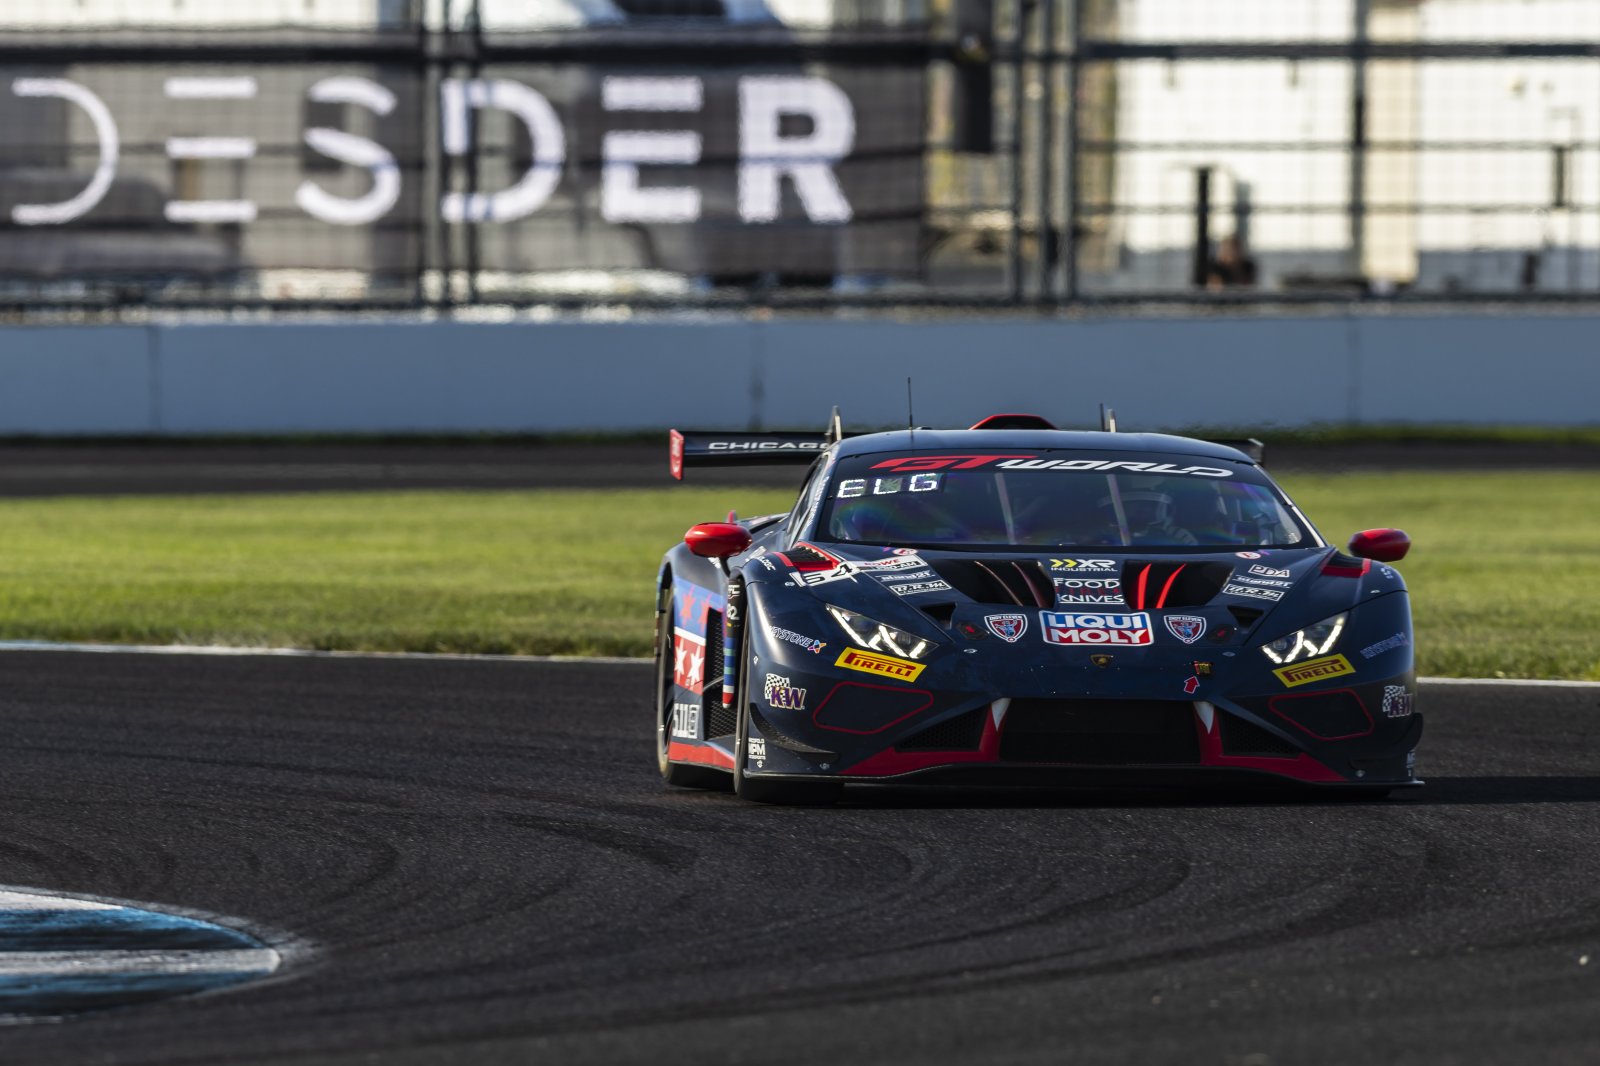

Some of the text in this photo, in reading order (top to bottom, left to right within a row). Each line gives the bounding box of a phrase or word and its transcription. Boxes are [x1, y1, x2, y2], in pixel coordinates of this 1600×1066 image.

[996, 459, 1234, 478] WORLD
[1076, 558, 1117, 568] XR
[1053, 578, 1120, 589] FOOD
[1056, 594, 1124, 603] KNIVES
[1048, 614, 1143, 629] LIQUI
[768, 626, 814, 648] EYSTONE
[1050, 629, 1147, 643] MOLY
[843, 653, 916, 677] PIRELLI
[1281, 659, 1346, 683] PIRELLI
[770, 687, 807, 710] KW
